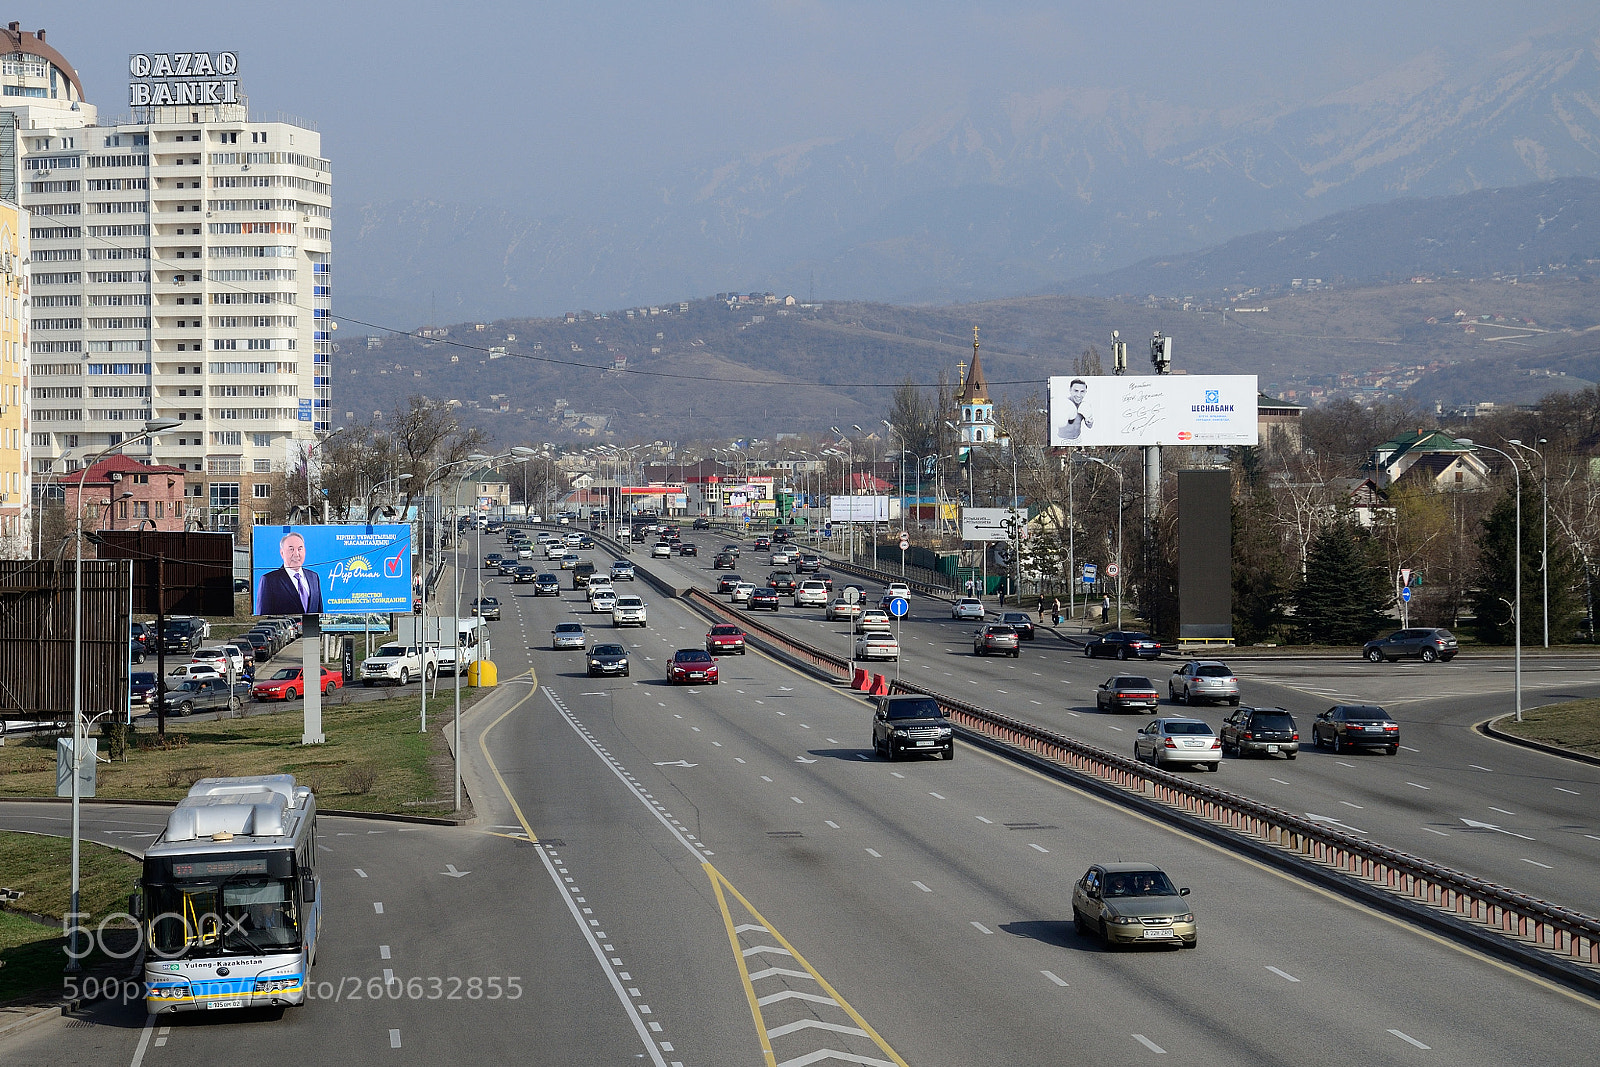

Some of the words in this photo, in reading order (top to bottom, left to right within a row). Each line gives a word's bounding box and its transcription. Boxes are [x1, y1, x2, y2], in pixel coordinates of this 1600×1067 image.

[130, 52, 238, 78] QAZAQ
[130, 80, 238, 106] BANKI
[1191, 404, 1235, 412] ЦЕСНАБАНК
[185, 959, 263, 969] Yutong-Kazakhstan
